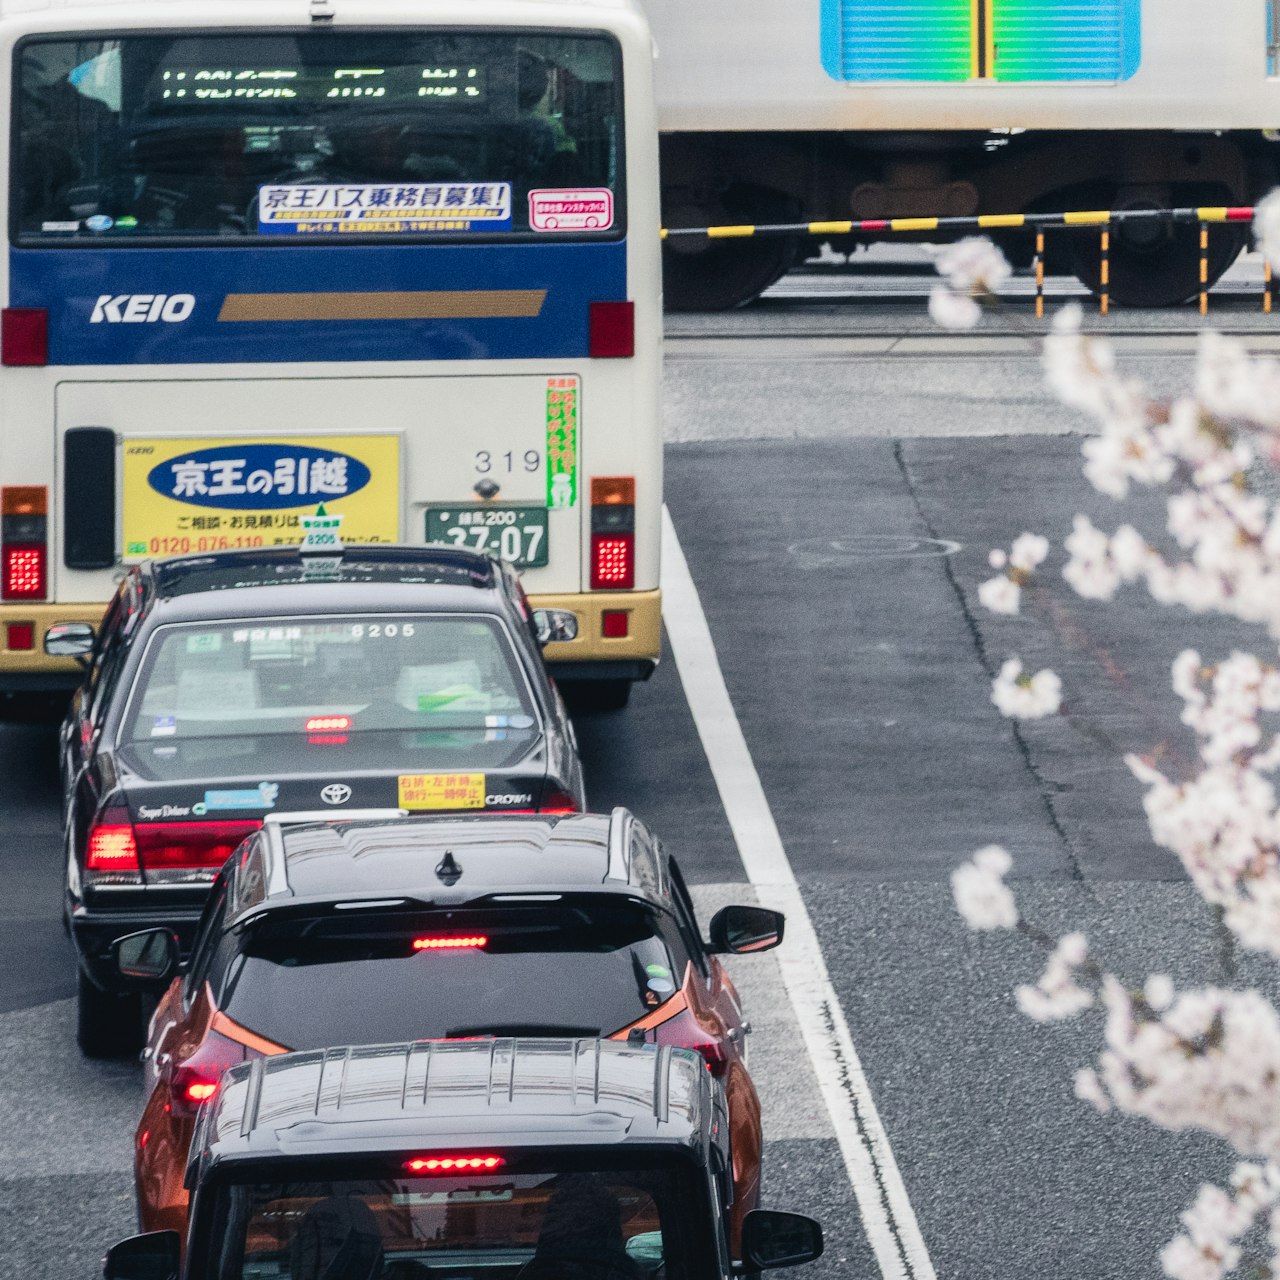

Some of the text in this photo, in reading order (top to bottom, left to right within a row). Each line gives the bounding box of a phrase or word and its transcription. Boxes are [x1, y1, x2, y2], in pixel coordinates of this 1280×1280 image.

[89, 294, 195, 323] KEIO
[475, 450, 540, 473] 319
[171, 457, 349, 497] 京王の引越
[351, 623, 415, 638] 8205
